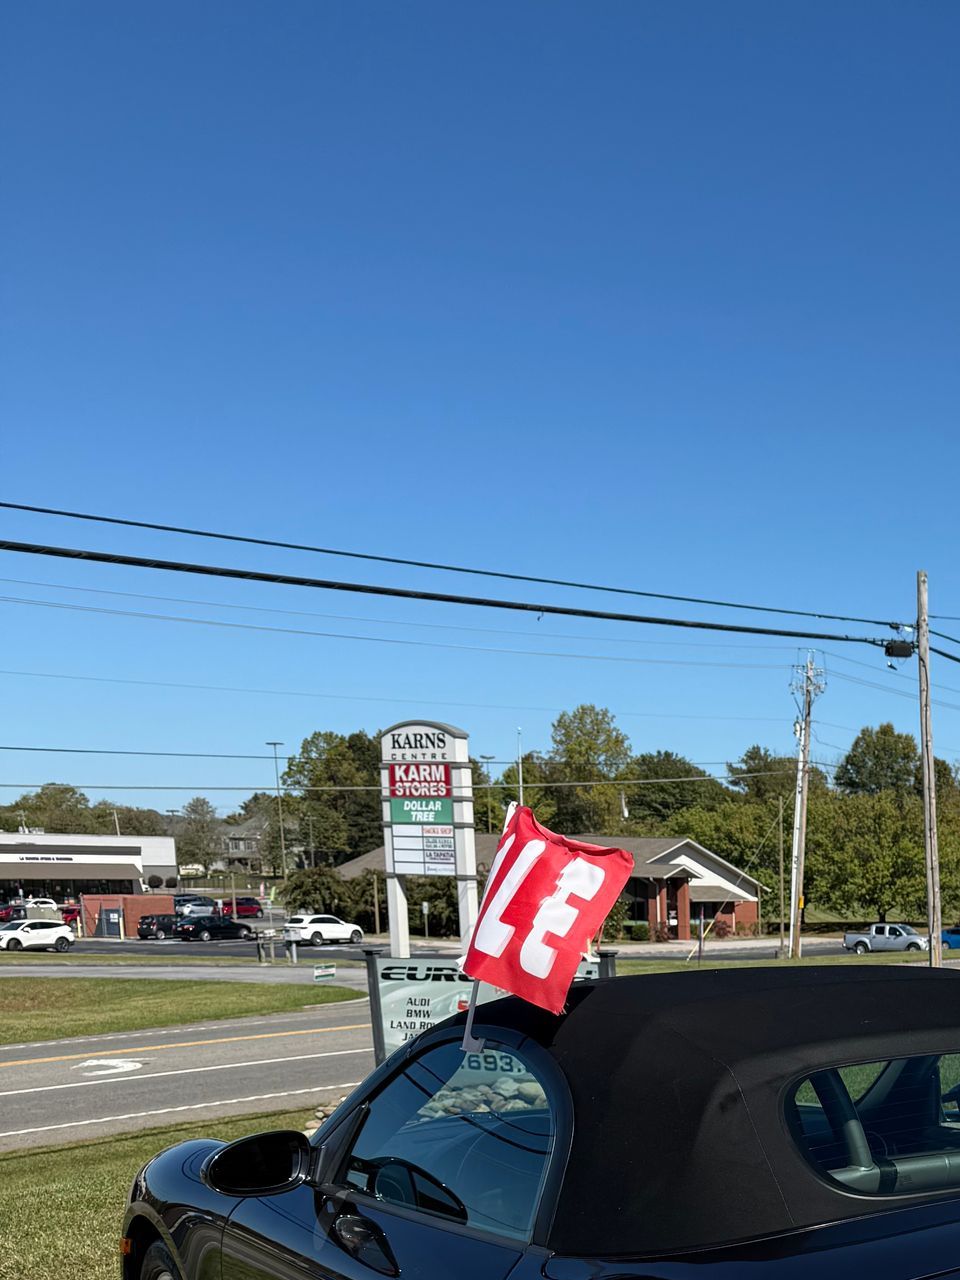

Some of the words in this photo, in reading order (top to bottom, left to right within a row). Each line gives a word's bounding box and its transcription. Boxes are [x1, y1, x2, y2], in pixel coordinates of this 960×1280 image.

[391, 732, 446, 750] KARNS
[391, 752, 447, 761] CENTRE
[394, 764, 446, 782] KARM
[395, 781, 447, 797] STORES
[403, 800, 442, 811] DOLLAR
[410, 811, 436, 821] TREE
[406, 997, 431, 1007] AUDI
[406, 1009, 432, 1018] BMW
[390, 1020, 417, 1030] LAND
